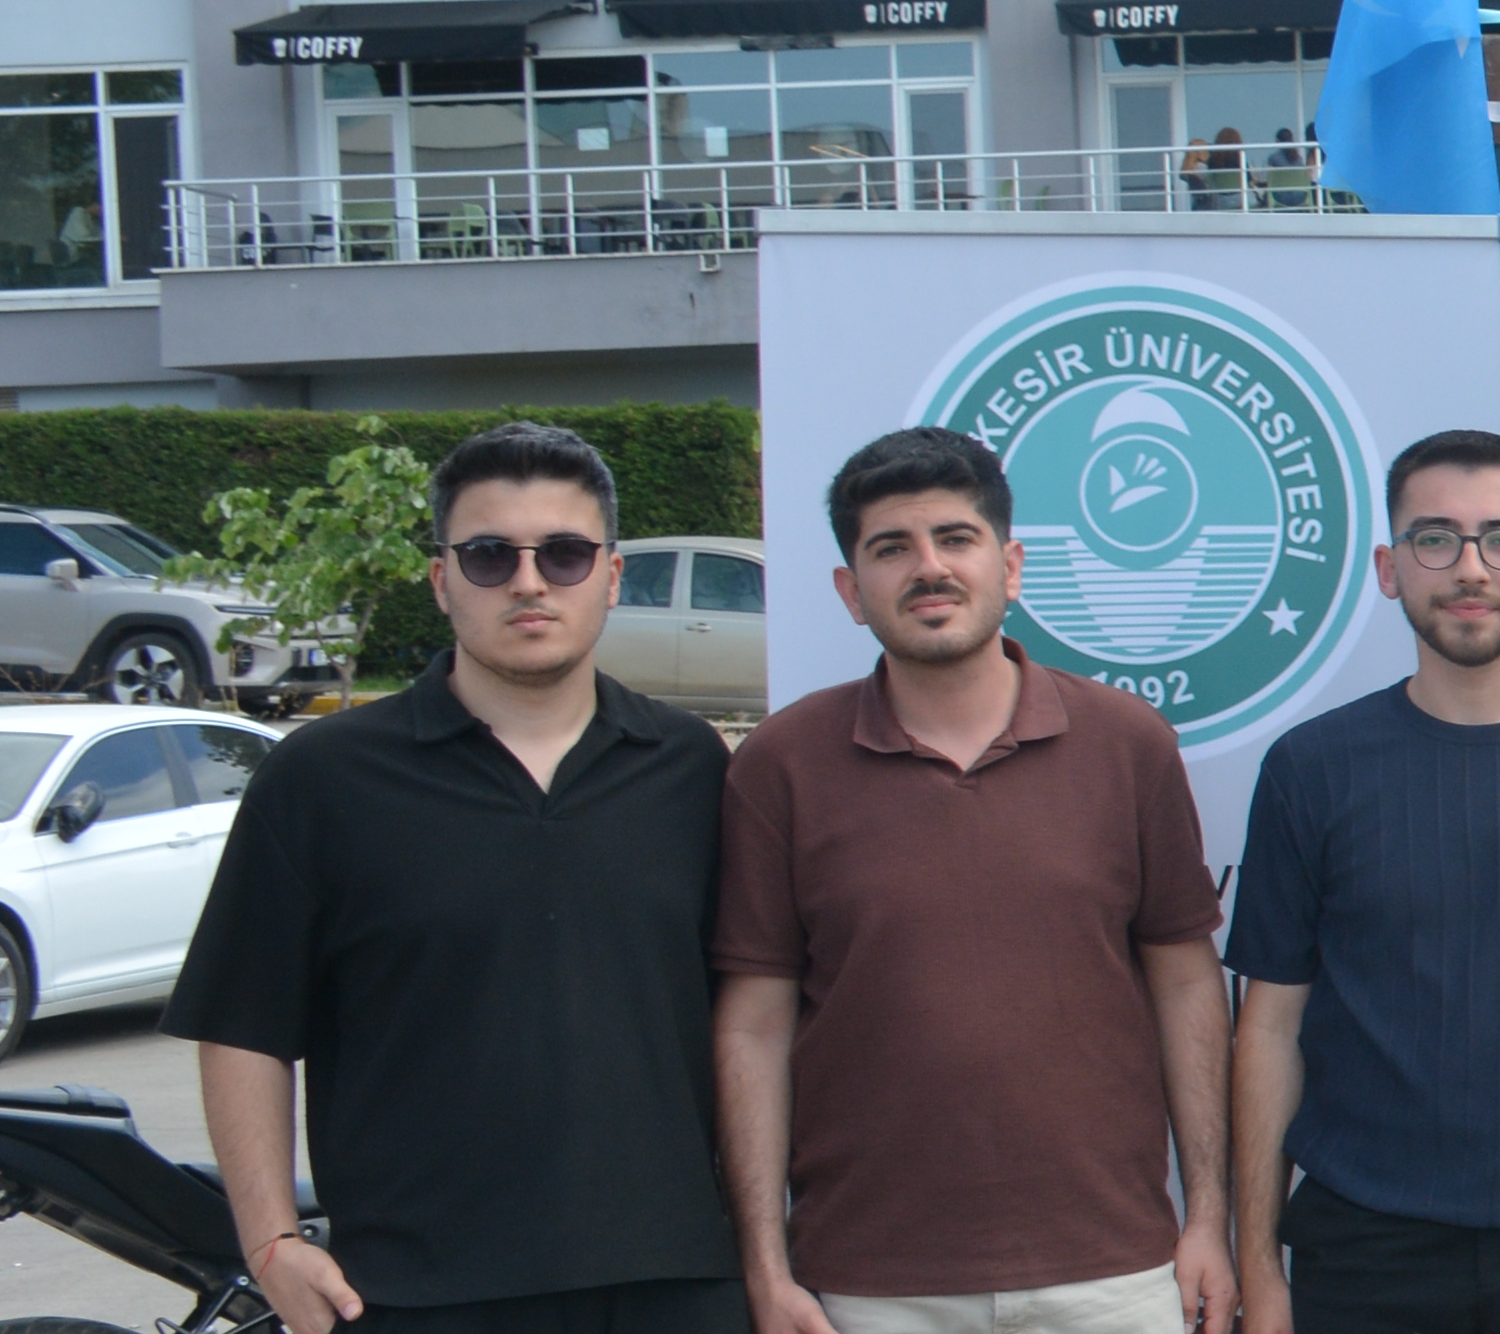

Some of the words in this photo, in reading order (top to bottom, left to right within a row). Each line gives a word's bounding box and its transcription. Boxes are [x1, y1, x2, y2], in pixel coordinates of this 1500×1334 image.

[887, 1, 948, 24] COFFY
[1116, 4, 1179, 28] COFFY
[296, 36, 363, 59] COFFY
[968, 342, 1094, 452] KESİR
[1103, 326, 1326, 564] ÜNİVERSİTESİ
